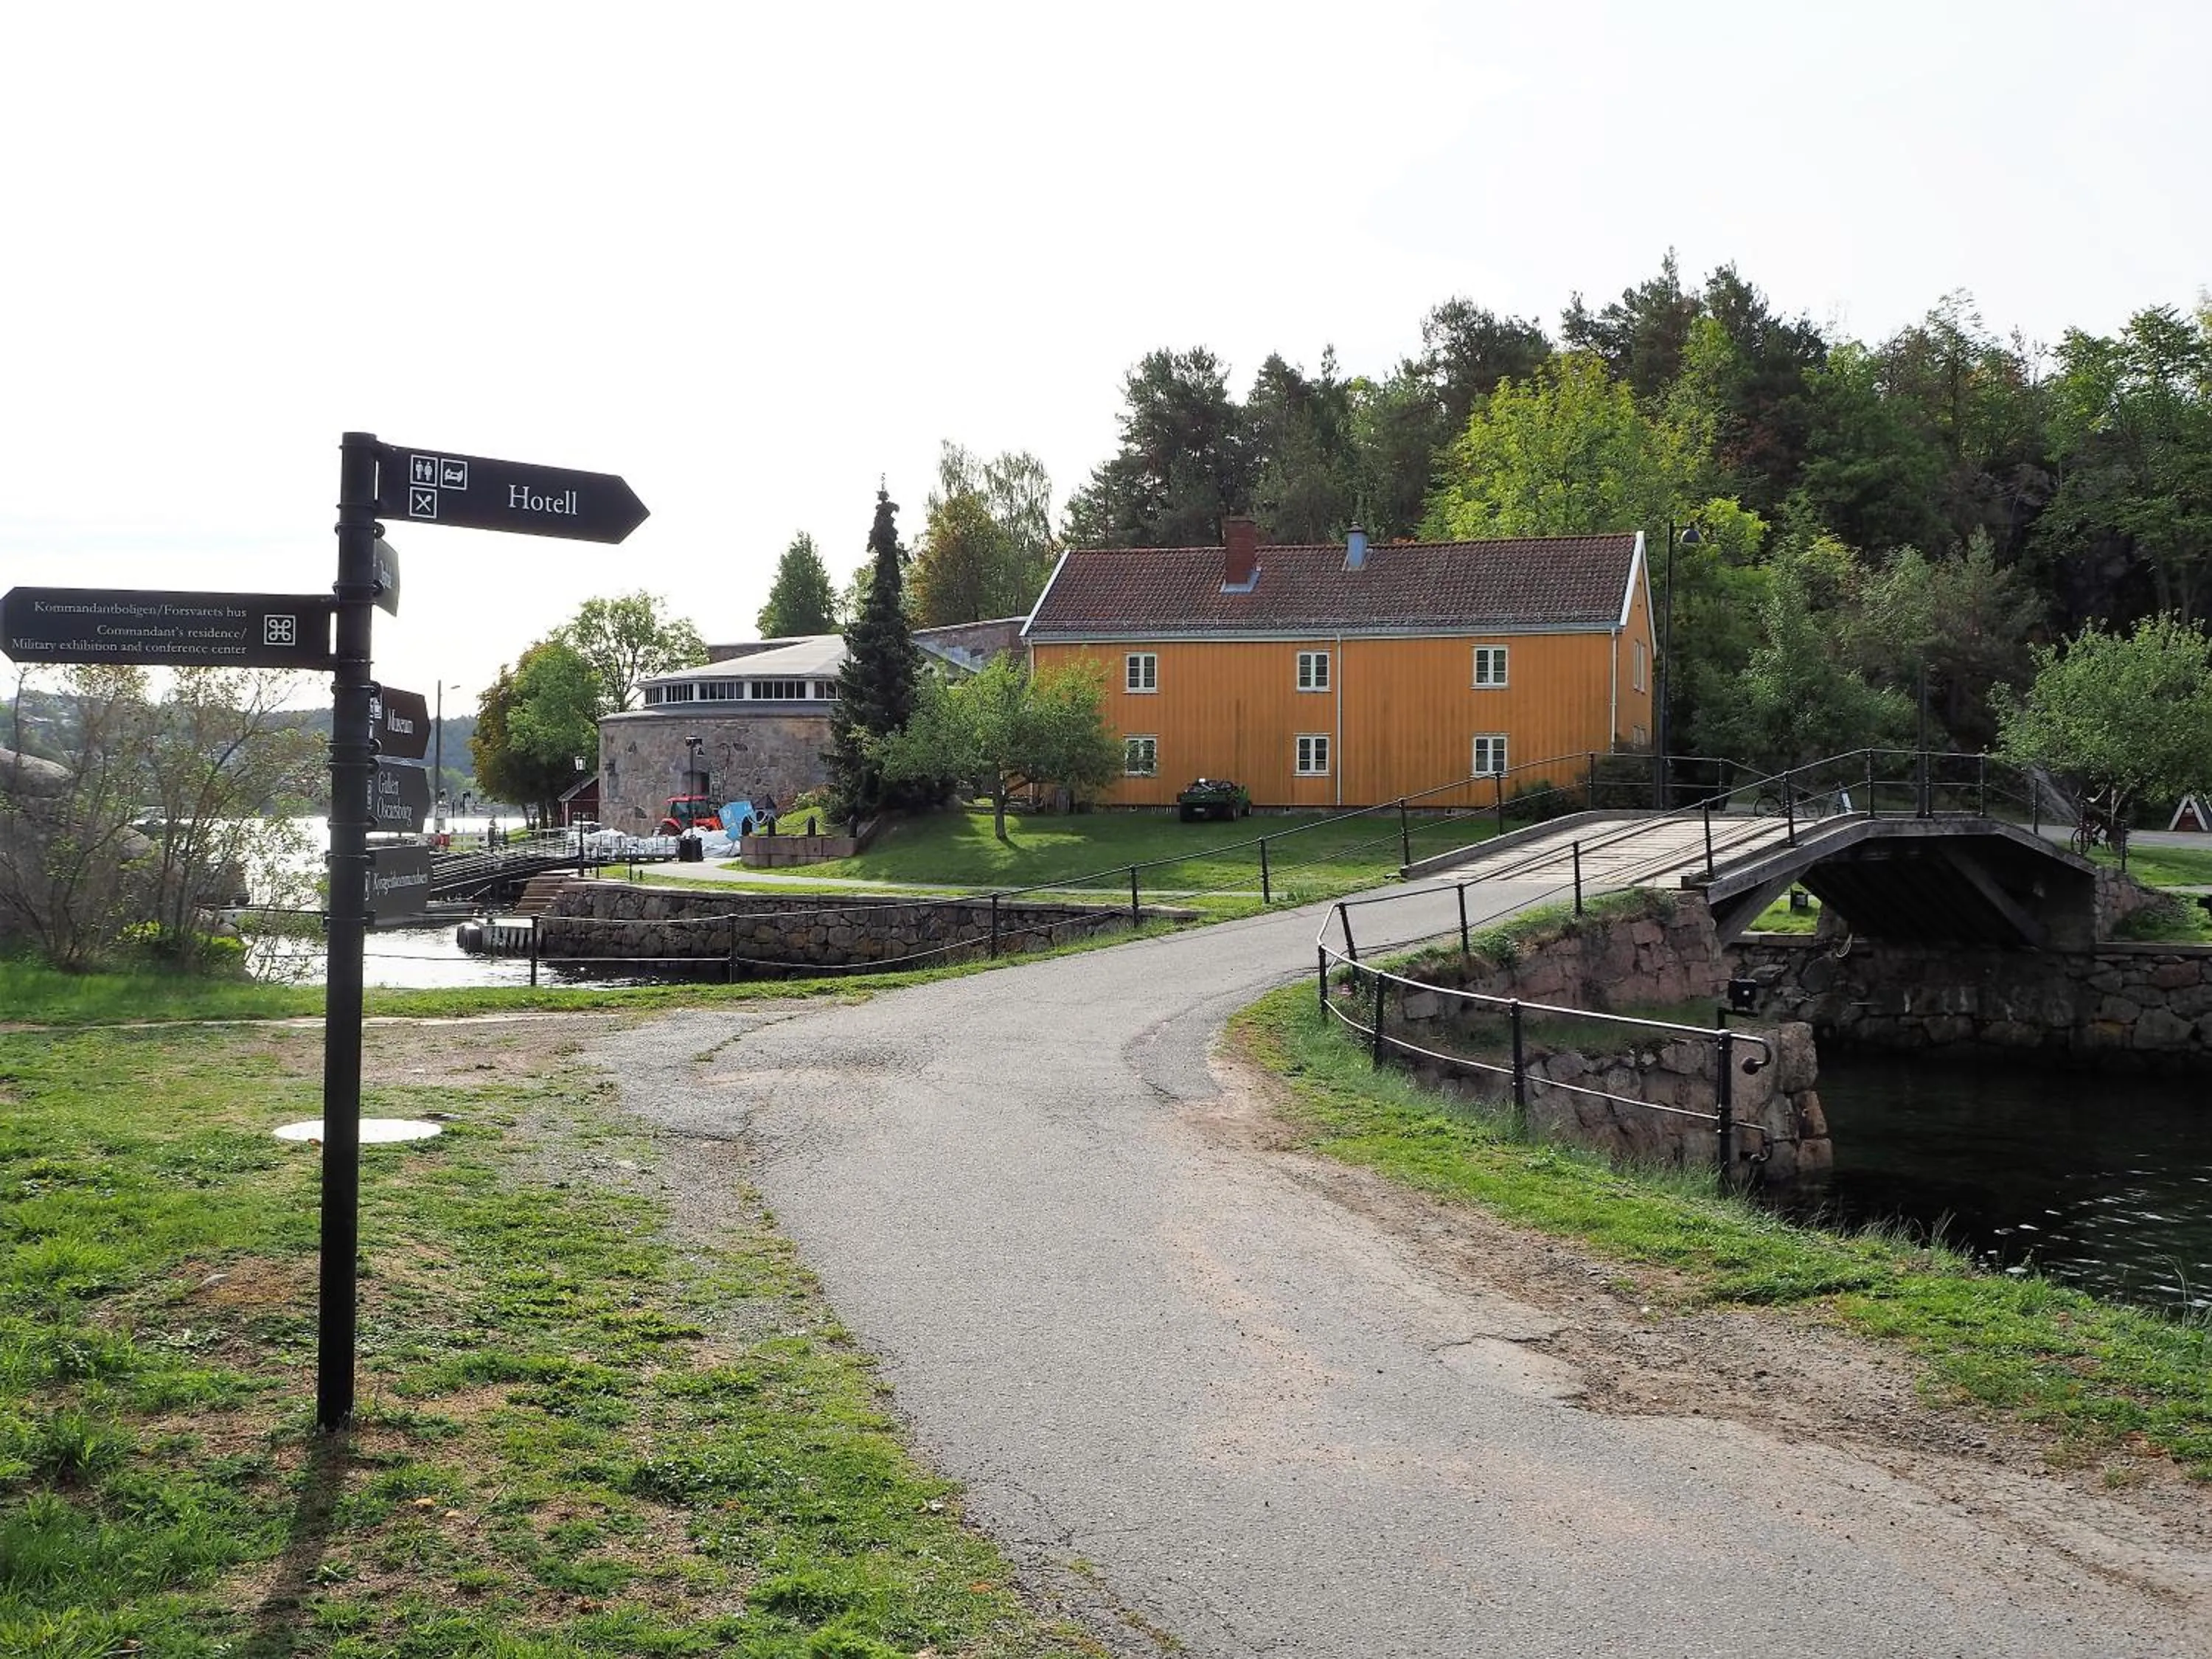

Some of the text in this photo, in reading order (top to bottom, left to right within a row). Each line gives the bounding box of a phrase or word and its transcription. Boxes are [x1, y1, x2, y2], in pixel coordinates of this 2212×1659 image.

[508, 484, 578, 515] Hotell
[226, 606, 247, 617] hus
[97, 625, 247, 639] Commandant's residence/
[11, 638, 247, 654] Military exhibition and conference center
[388, 708, 413, 734] Museum
